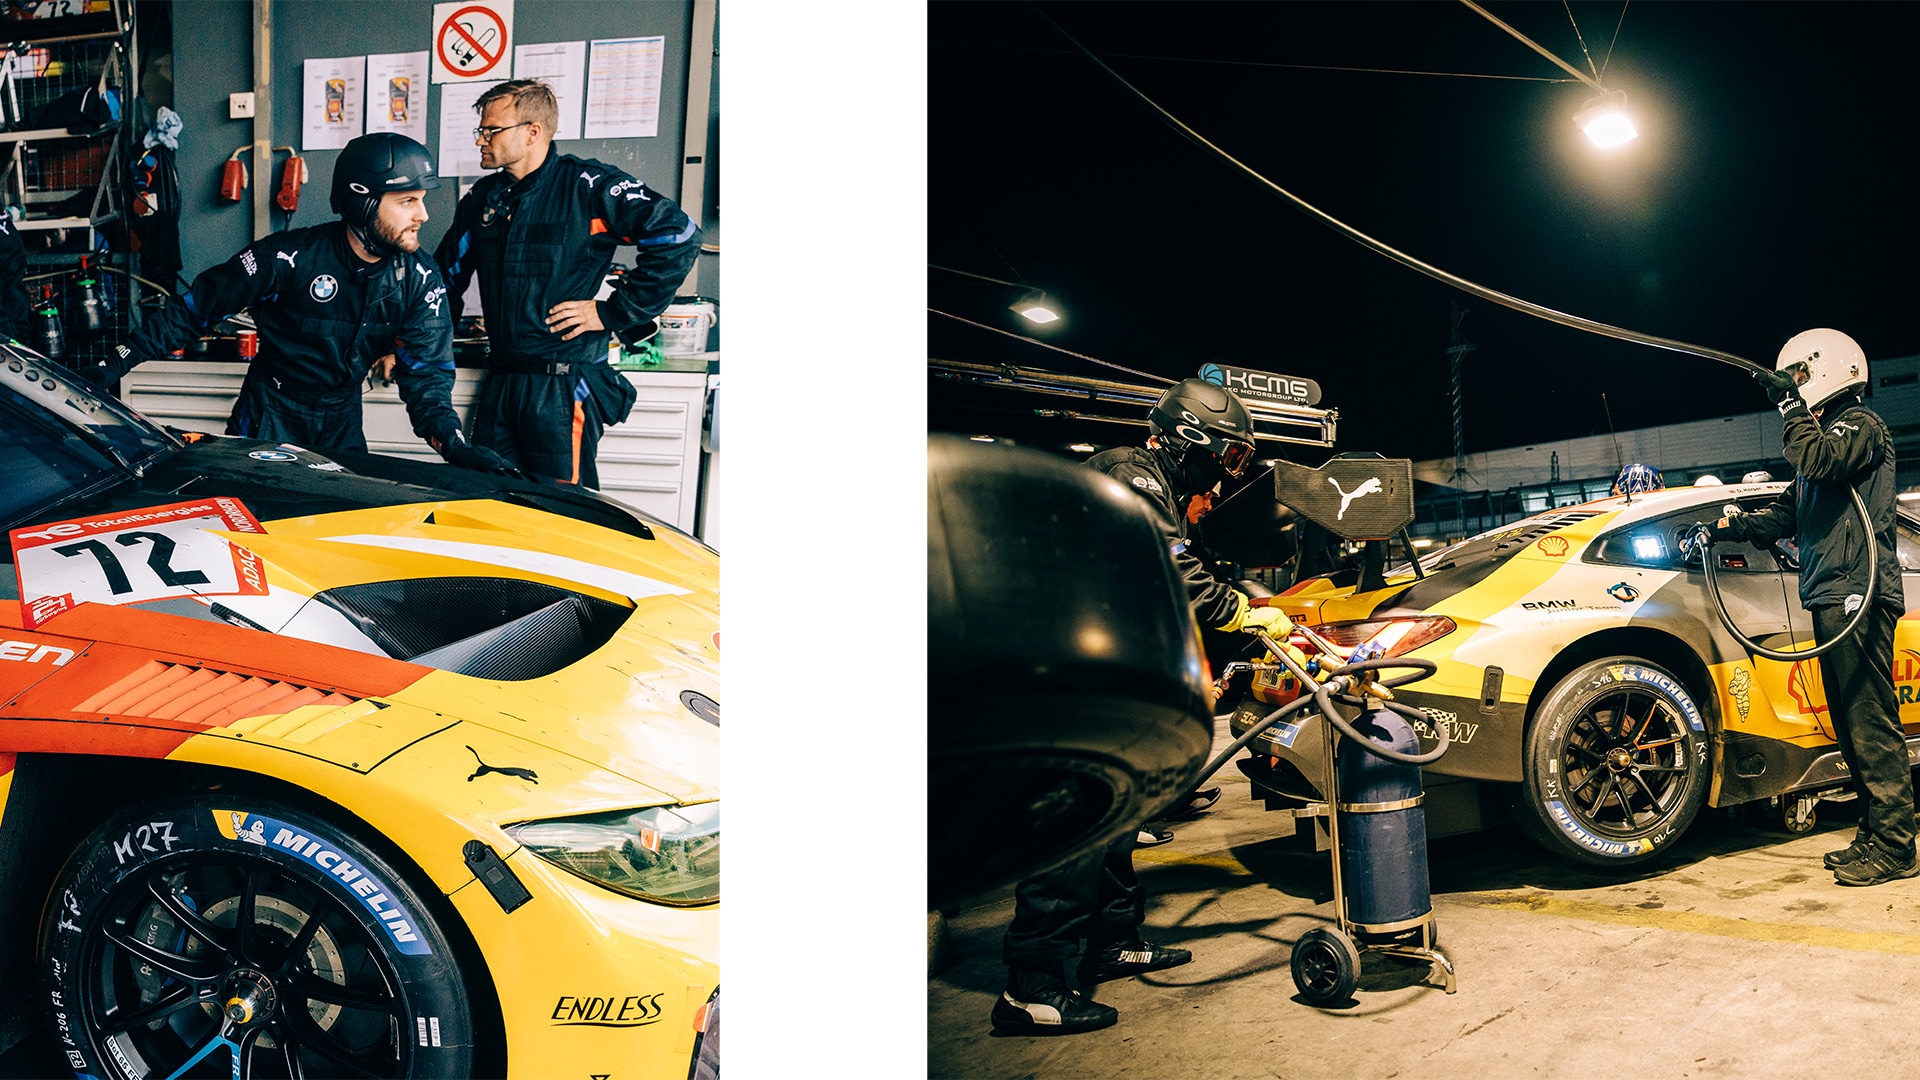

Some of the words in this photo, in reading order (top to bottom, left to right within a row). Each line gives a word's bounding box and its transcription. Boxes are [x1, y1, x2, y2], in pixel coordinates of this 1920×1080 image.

[1226, 369, 1308, 398] KCMG
[1240, 388, 1292, 401] MOTORGROUP
[83, 504, 214, 530] TotalEnergies
[50, 530, 212, 596] 72
[240, 547, 263, 593] ADAC
[1521, 599, 1577, 611] BMW
[1639, 669, 1701, 726] MICHELIN
[113, 821, 180, 864] M27
[1554, 806, 1624, 854] MICHELIN
[272, 828, 418, 943] MICHELIN
[1118, 950, 1153, 964] PUMA
[551, 993, 664, 1021] ENDLESS
[231, 1053, 240, 1078] FR
